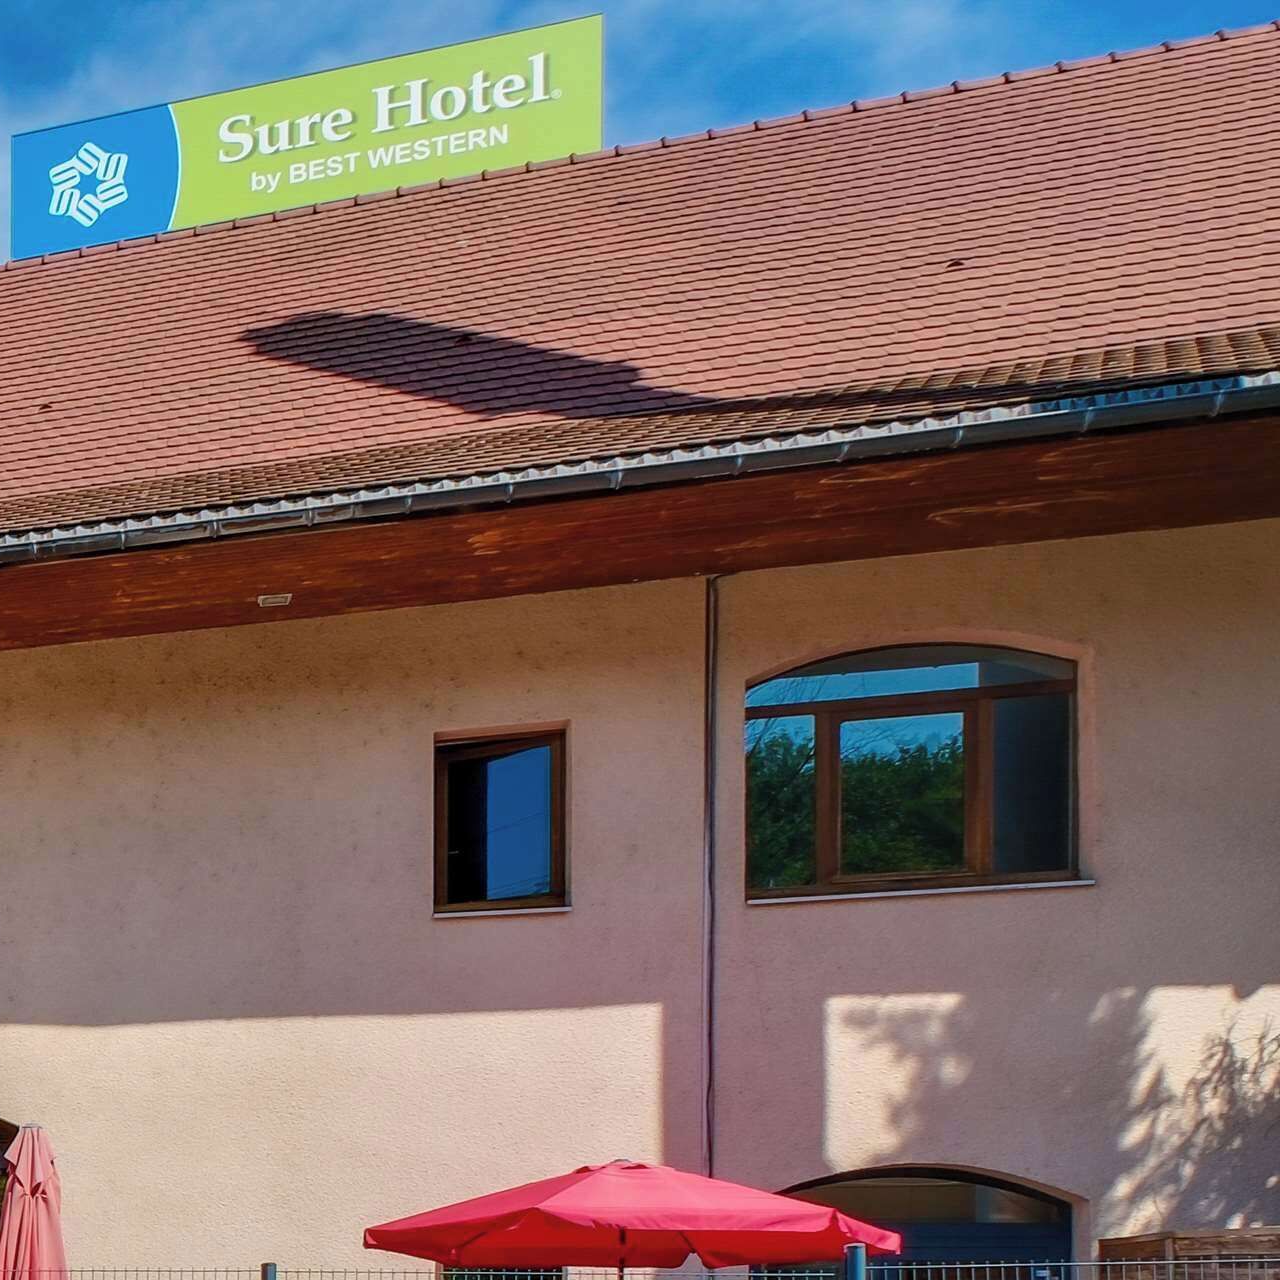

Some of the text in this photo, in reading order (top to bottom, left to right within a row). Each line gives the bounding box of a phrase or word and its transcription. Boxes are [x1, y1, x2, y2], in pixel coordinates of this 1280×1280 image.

[218, 52, 551, 163] Sure Hotel
[251, 124, 510, 193] by BEST WESTERN
